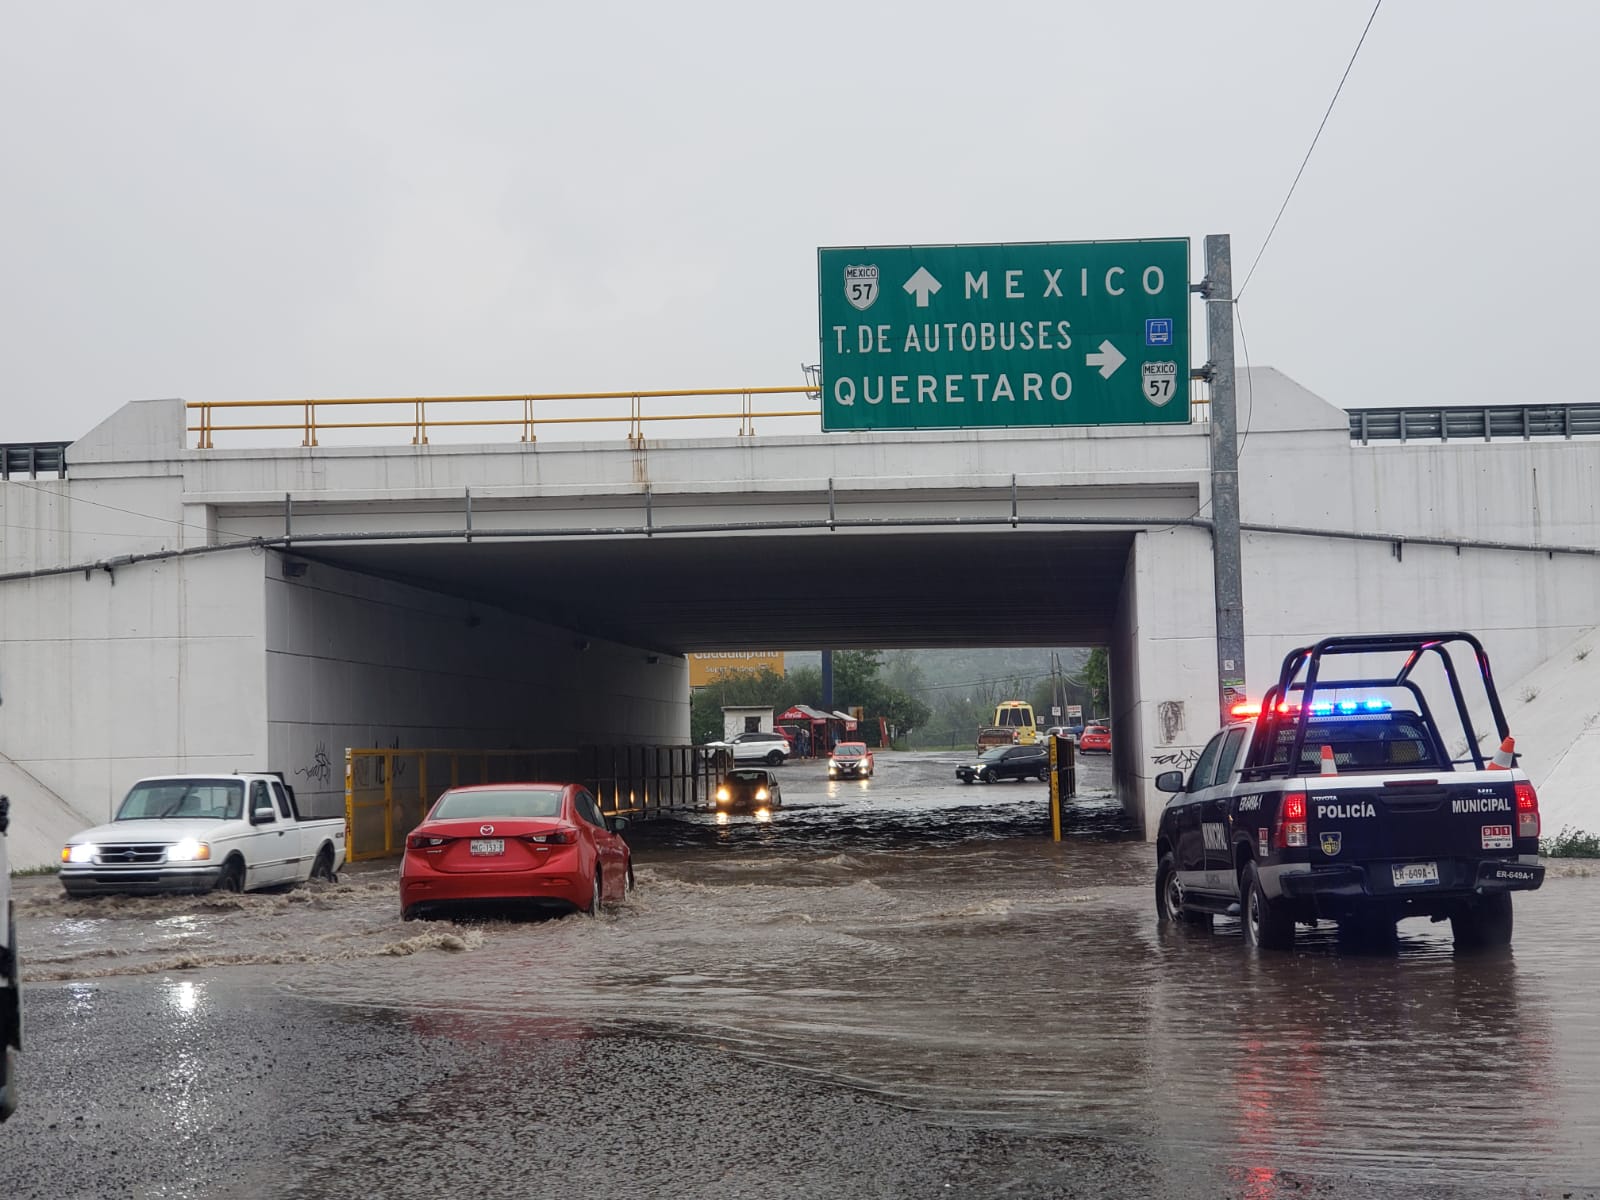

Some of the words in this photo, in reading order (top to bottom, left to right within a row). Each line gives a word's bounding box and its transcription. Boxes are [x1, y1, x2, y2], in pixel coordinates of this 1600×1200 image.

[846, 268, 877, 278] MEXICO
[964, 265, 1165, 300] MEXICO
[852, 283, 873, 301] 57
[832, 325, 851, 354] T.
[858, 324, 892, 353] DE
[903, 320, 1073, 352] AUTOBUSES
[1144, 364, 1175, 374] MEXICO
[834, 371, 1073, 406] QUERETARO
[1149, 379, 1170, 397] 57
[1317, 801, 1376, 819] POLICÍA
[1452, 798, 1512, 814] MUNICIPAL
[1483, 827, 1511, 836] 911
[1394, 867, 1437, 881] ER-649A-1
[1495, 870, 1534, 880] ER-649A-1
